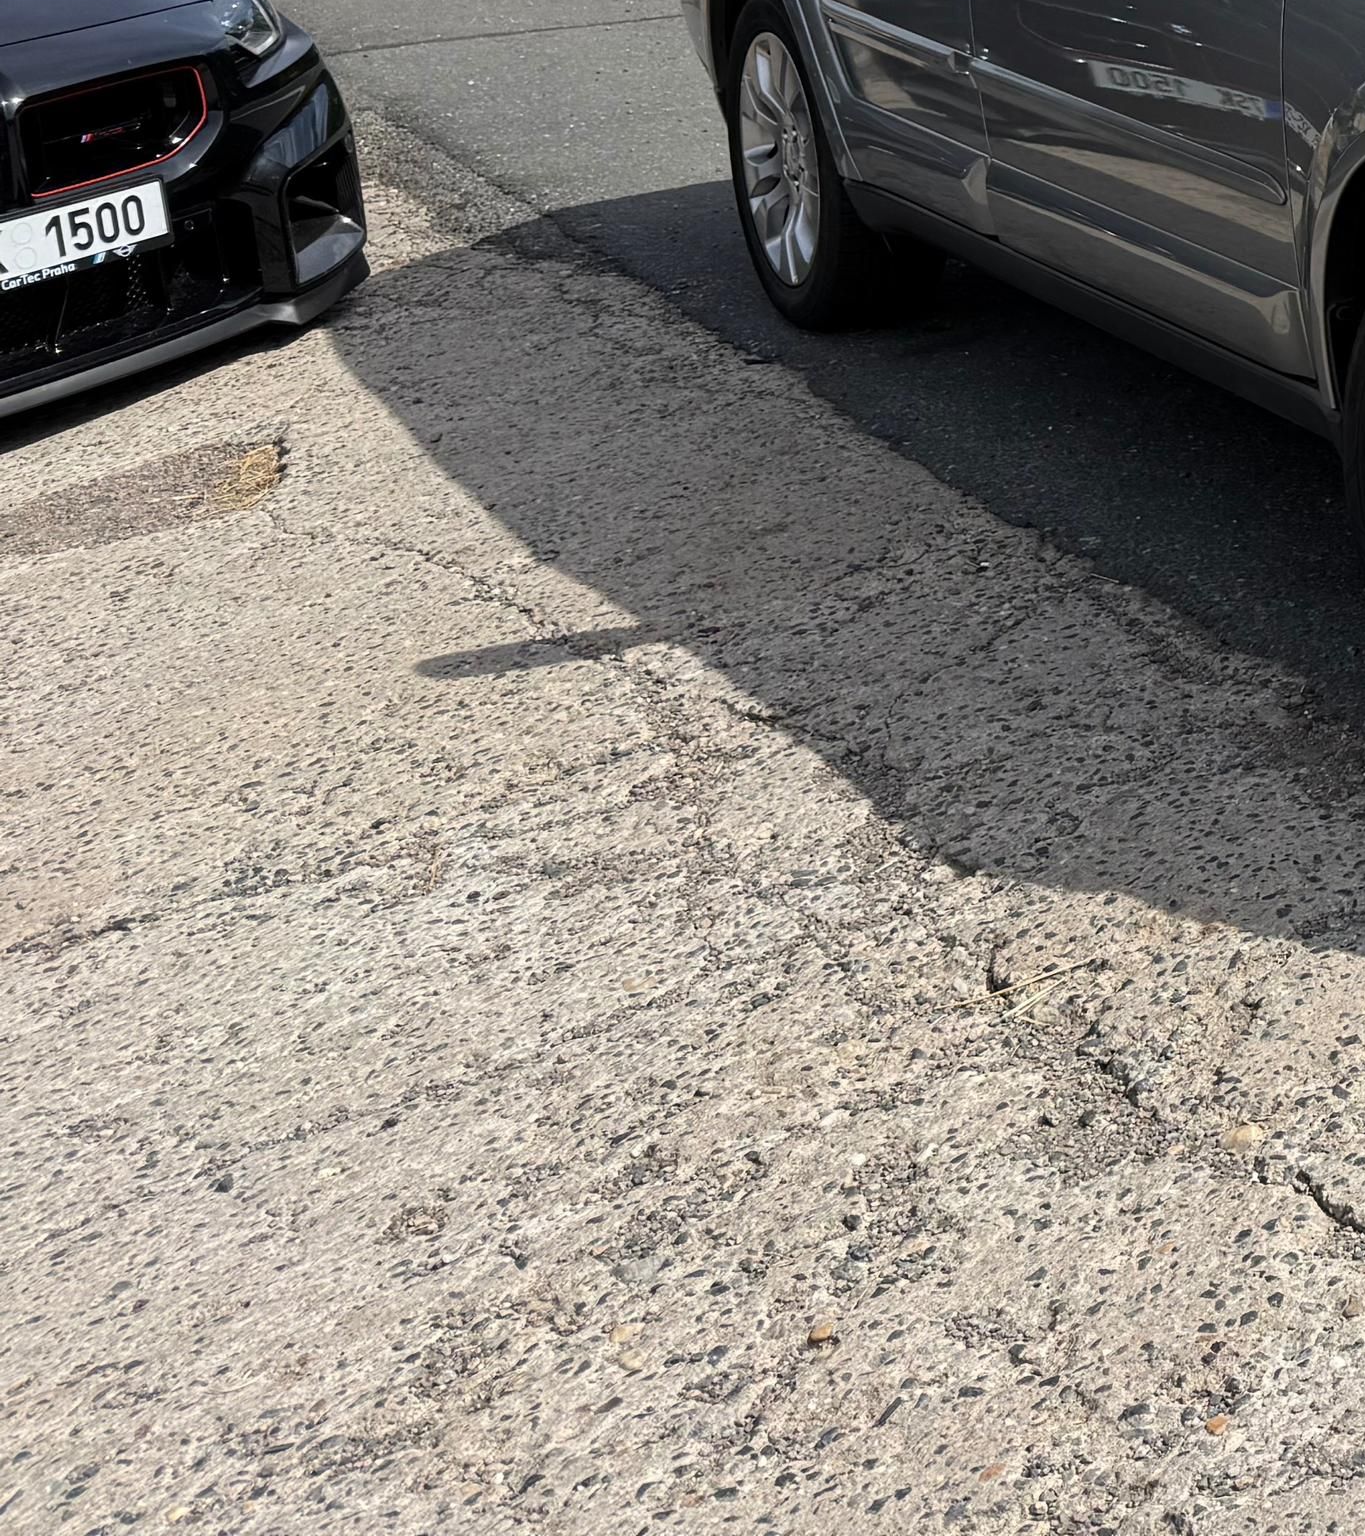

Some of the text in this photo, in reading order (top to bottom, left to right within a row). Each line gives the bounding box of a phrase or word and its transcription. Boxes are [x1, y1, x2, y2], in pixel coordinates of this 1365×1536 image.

[45, 195, 146, 258] 1500
[1, 263, 77, 291] CarTec Praha
